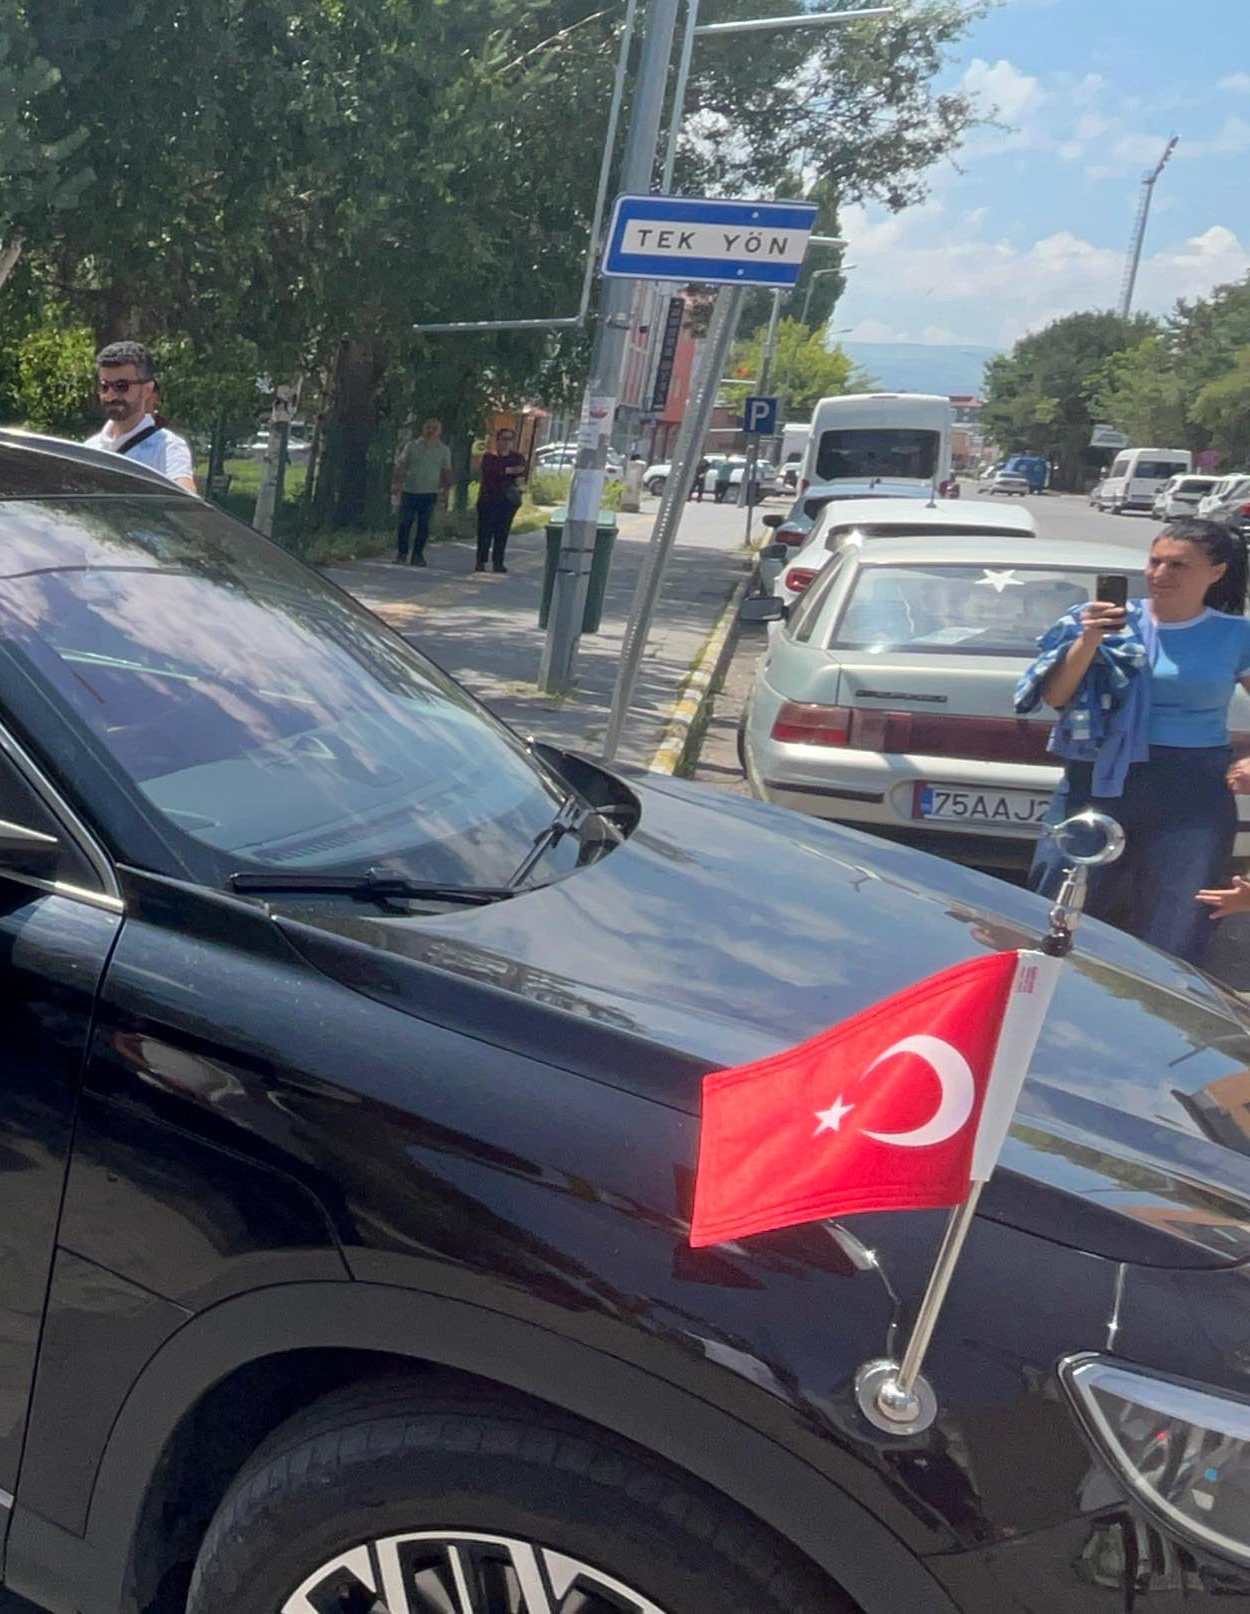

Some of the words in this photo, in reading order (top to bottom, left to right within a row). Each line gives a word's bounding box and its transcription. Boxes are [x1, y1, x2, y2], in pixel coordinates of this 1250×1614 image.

[637, 229, 696, 250] TEK
[723, 231, 789, 255] YÖN
[751, 401, 770, 430] P
